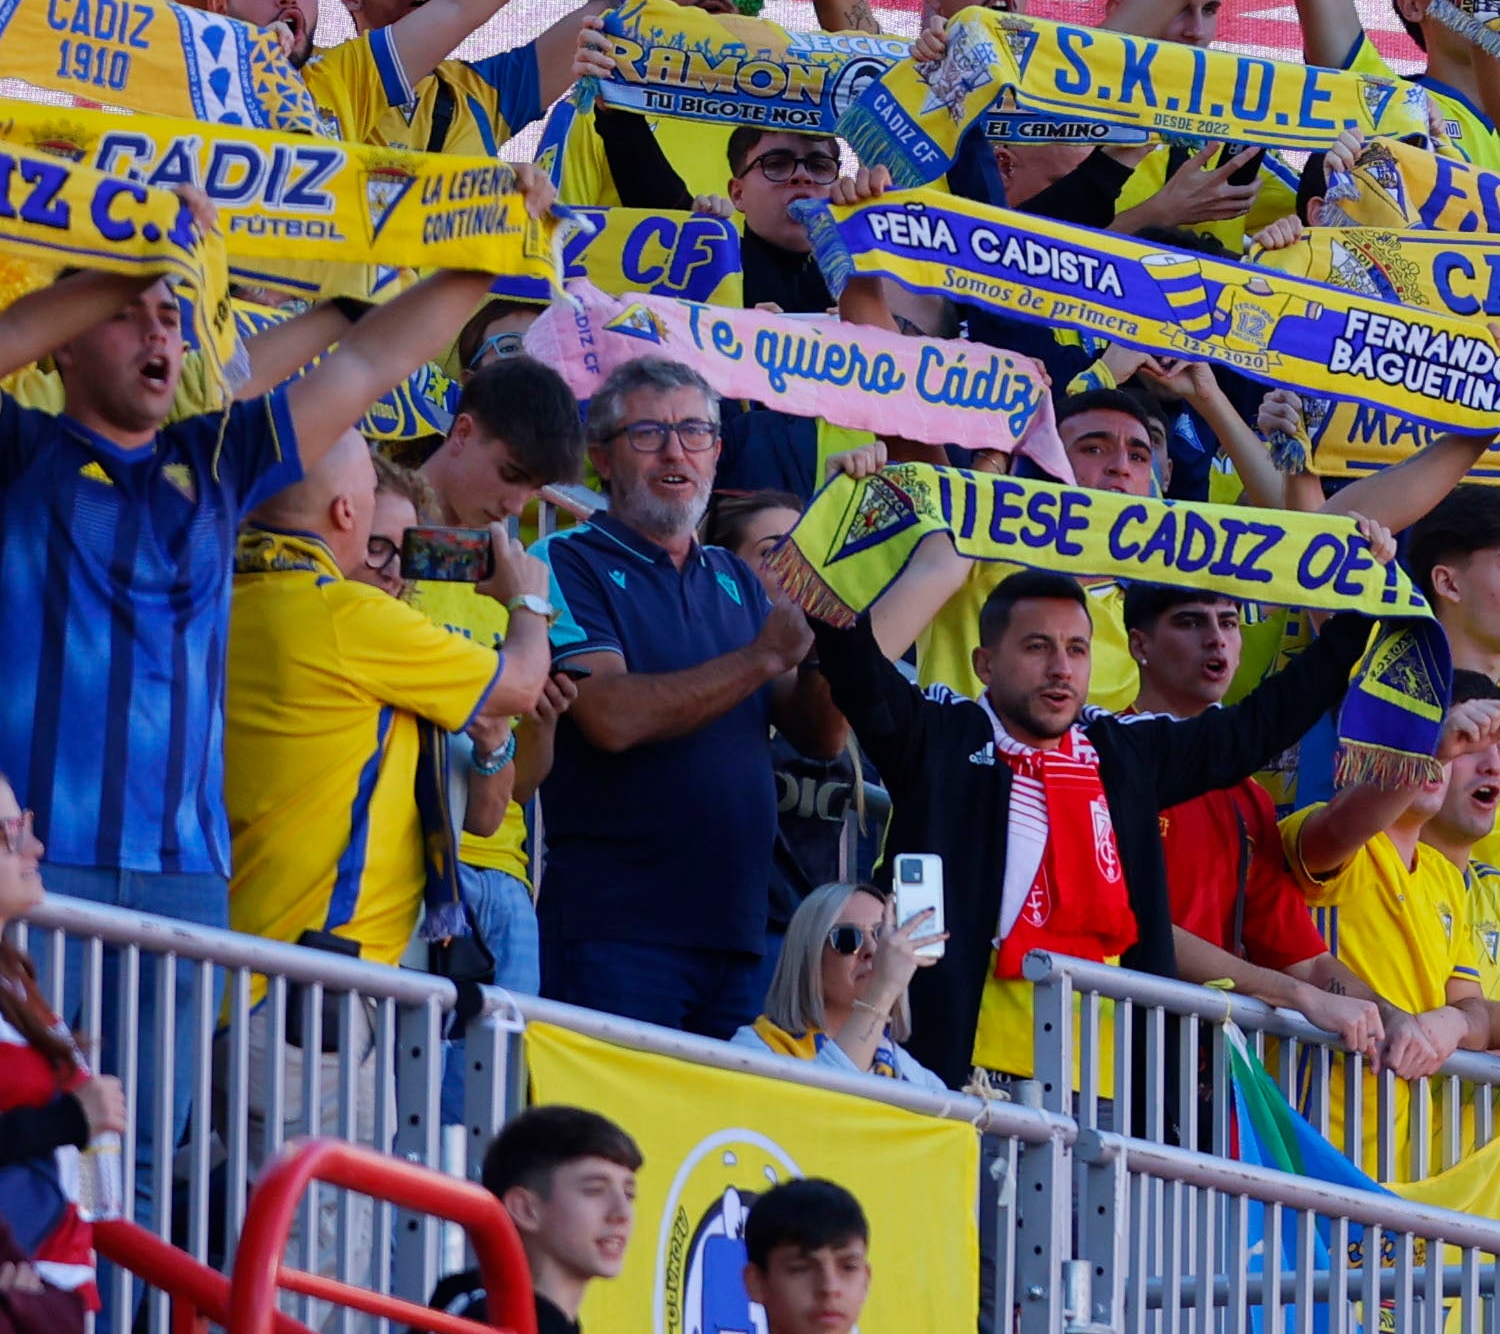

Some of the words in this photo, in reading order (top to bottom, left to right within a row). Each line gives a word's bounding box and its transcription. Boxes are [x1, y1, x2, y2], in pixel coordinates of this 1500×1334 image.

[56, 40, 131, 91] 1910
[602, 35, 830, 104] RAMON
[642, 89, 674, 111] TU
[678, 96, 766, 123] BIGOTE
[770, 107, 822, 128] NOS
[870, 93, 921, 147] CÁDIZ
[912, 140, 941, 165] CF
[985, 120, 1013, 138] EL
[1019, 120, 1111, 139] CAMINO
[1152, 112, 1192, 133] DESDE
[1197, 118, 1231, 135] 2022
[95, 130, 348, 216] CÁDIZ
[421, 174, 444, 205] LA
[229, 213, 347, 241] FÚTBOL
[867, 202, 958, 255] PEÑA
[971, 228, 1125, 298] CADISTA
[942, 266, 1013, 301] Somos
[1018, 288, 1045, 310] de
[1049, 297, 1141, 338] primera
[680, 299, 743, 361] Te
[755, 328, 906, 395] quiero
[915, 345, 1041, 438] Cádiz
[1108, 497, 1288, 584] CÁDIZ
